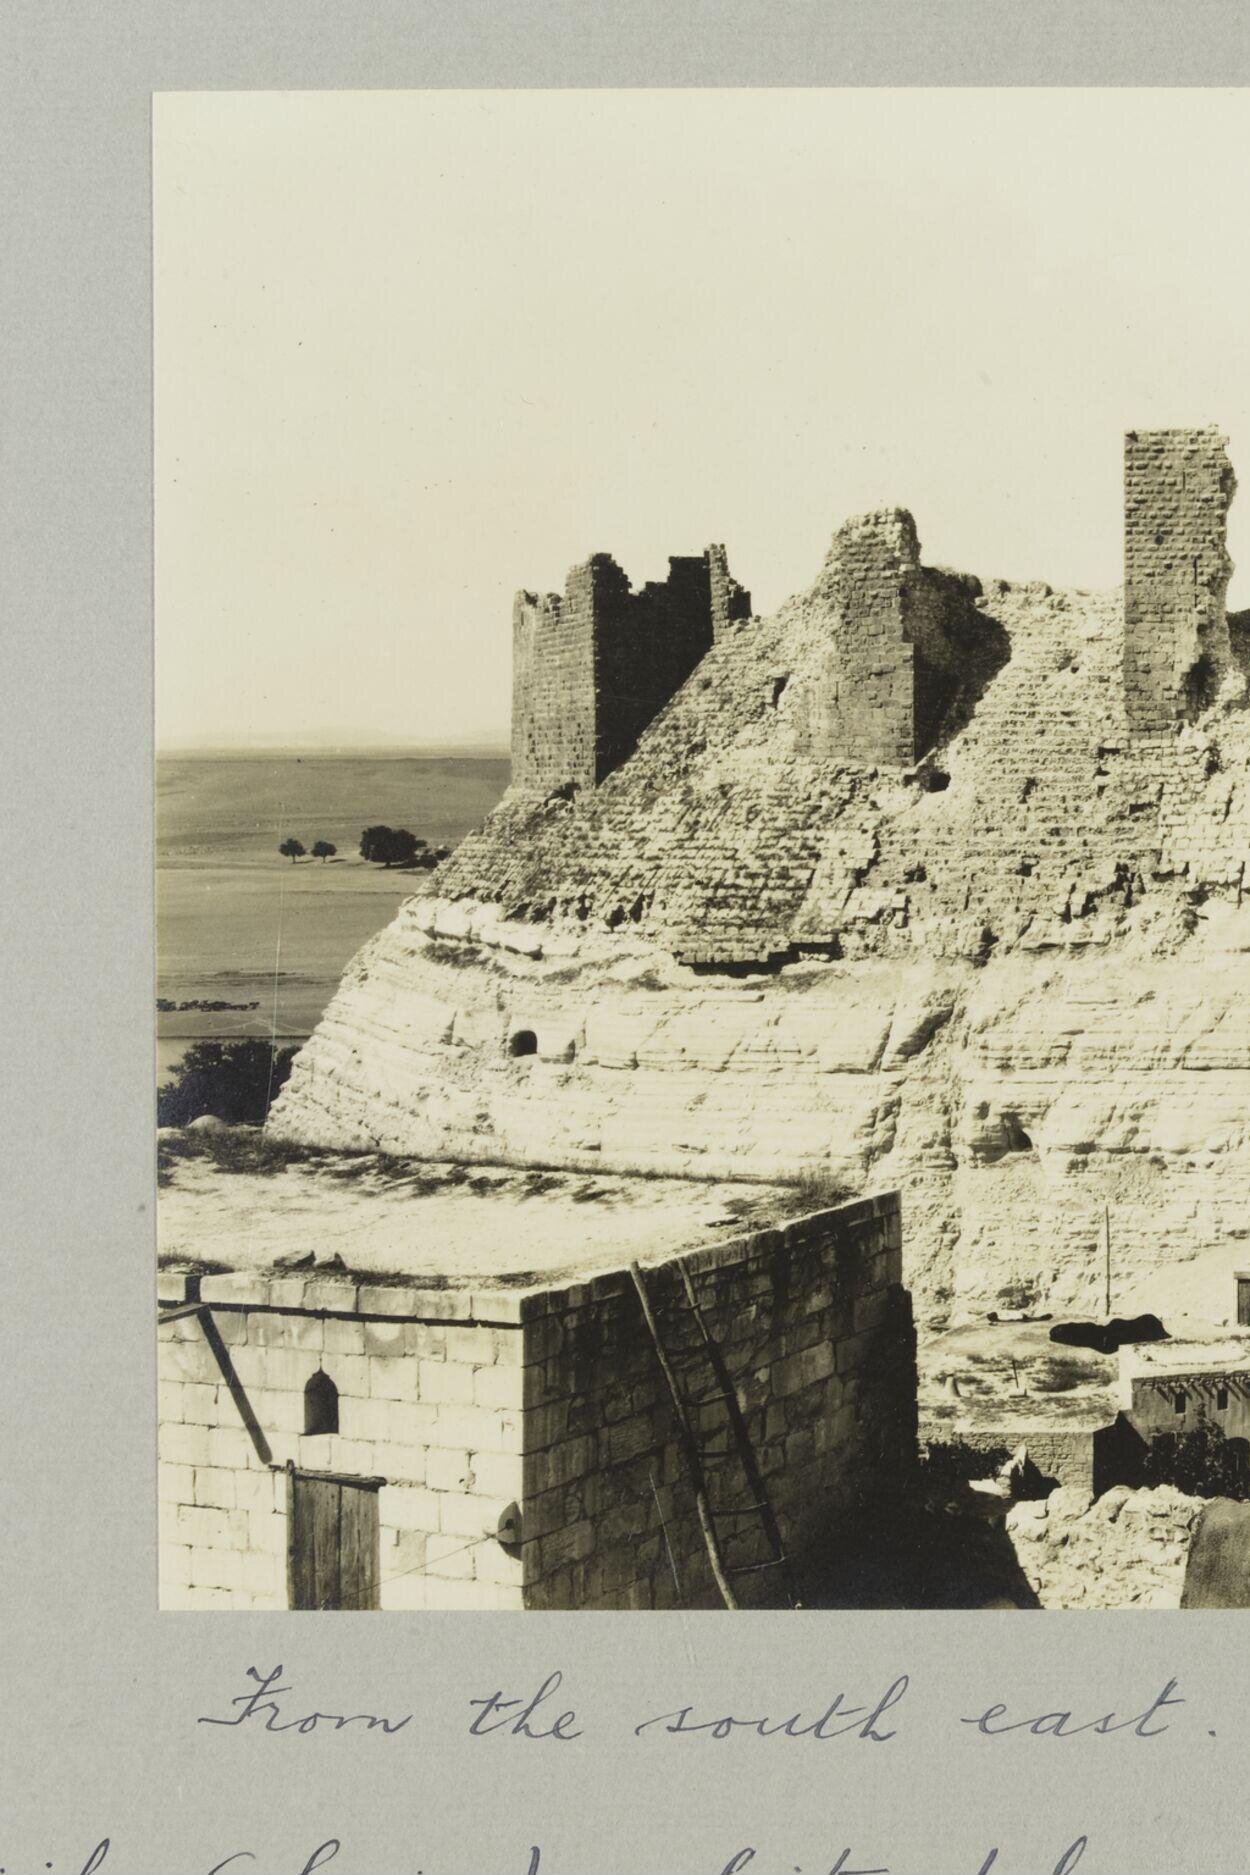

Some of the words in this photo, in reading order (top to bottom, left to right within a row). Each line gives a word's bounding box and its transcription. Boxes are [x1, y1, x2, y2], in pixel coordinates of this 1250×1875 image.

[197, 1663, 413, 1735] From
[469, 1670, 585, 1741] the
[635, 1674, 910, 1742] south
